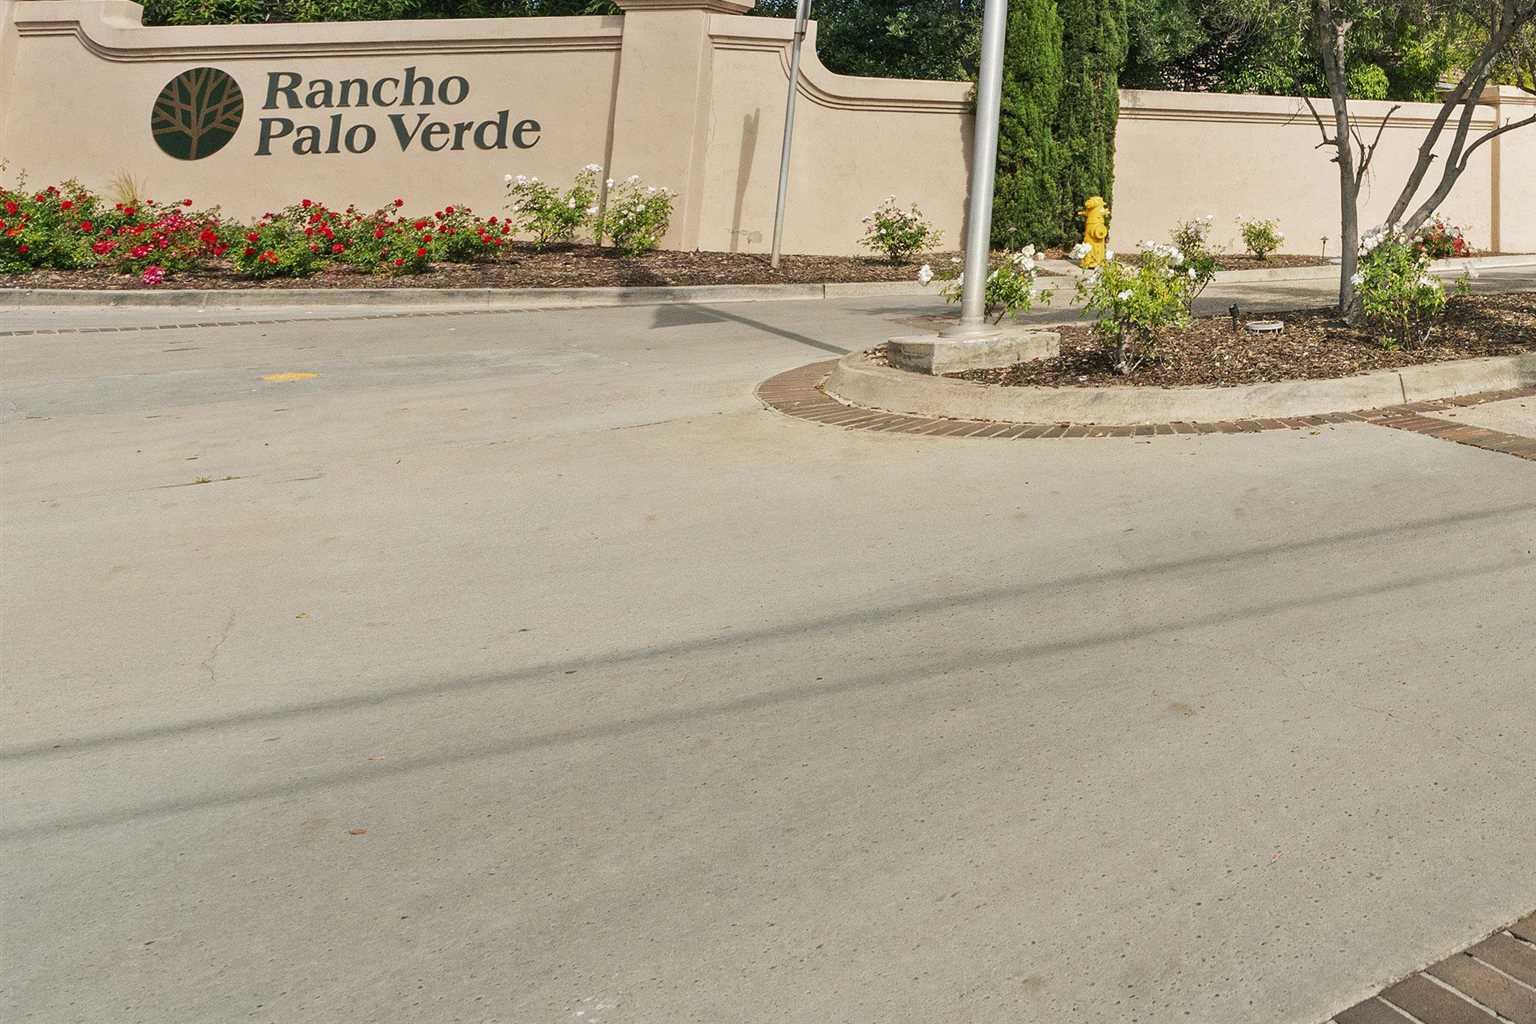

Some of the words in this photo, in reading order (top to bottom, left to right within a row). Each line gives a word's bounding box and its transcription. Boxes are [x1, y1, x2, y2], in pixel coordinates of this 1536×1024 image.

[261, 66, 470, 110] Rancho
[254, 114, 377, 157] Palo
[388, 109, 542, 152] Verde
